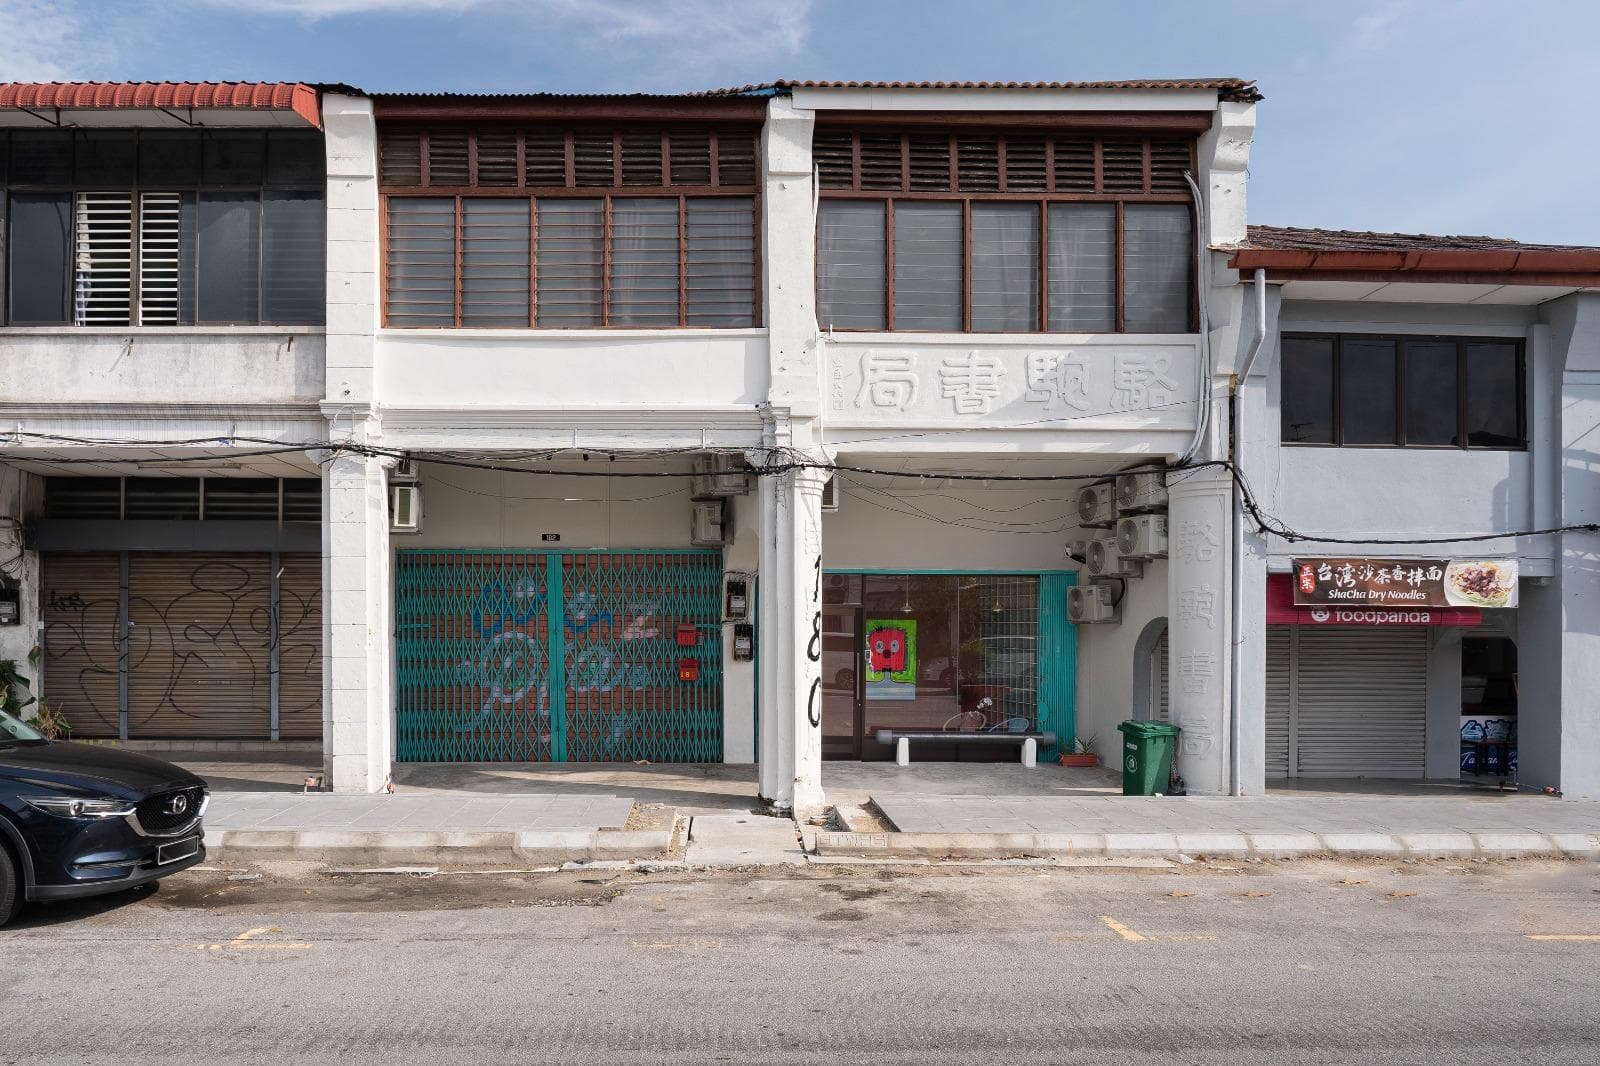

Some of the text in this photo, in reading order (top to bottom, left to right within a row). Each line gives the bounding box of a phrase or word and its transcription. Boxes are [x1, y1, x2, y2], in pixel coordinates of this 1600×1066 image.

[1328, 589, 1427, 601] ShaCha Dry Noodles
[1335, 608, 1431, 624] foodpanda
